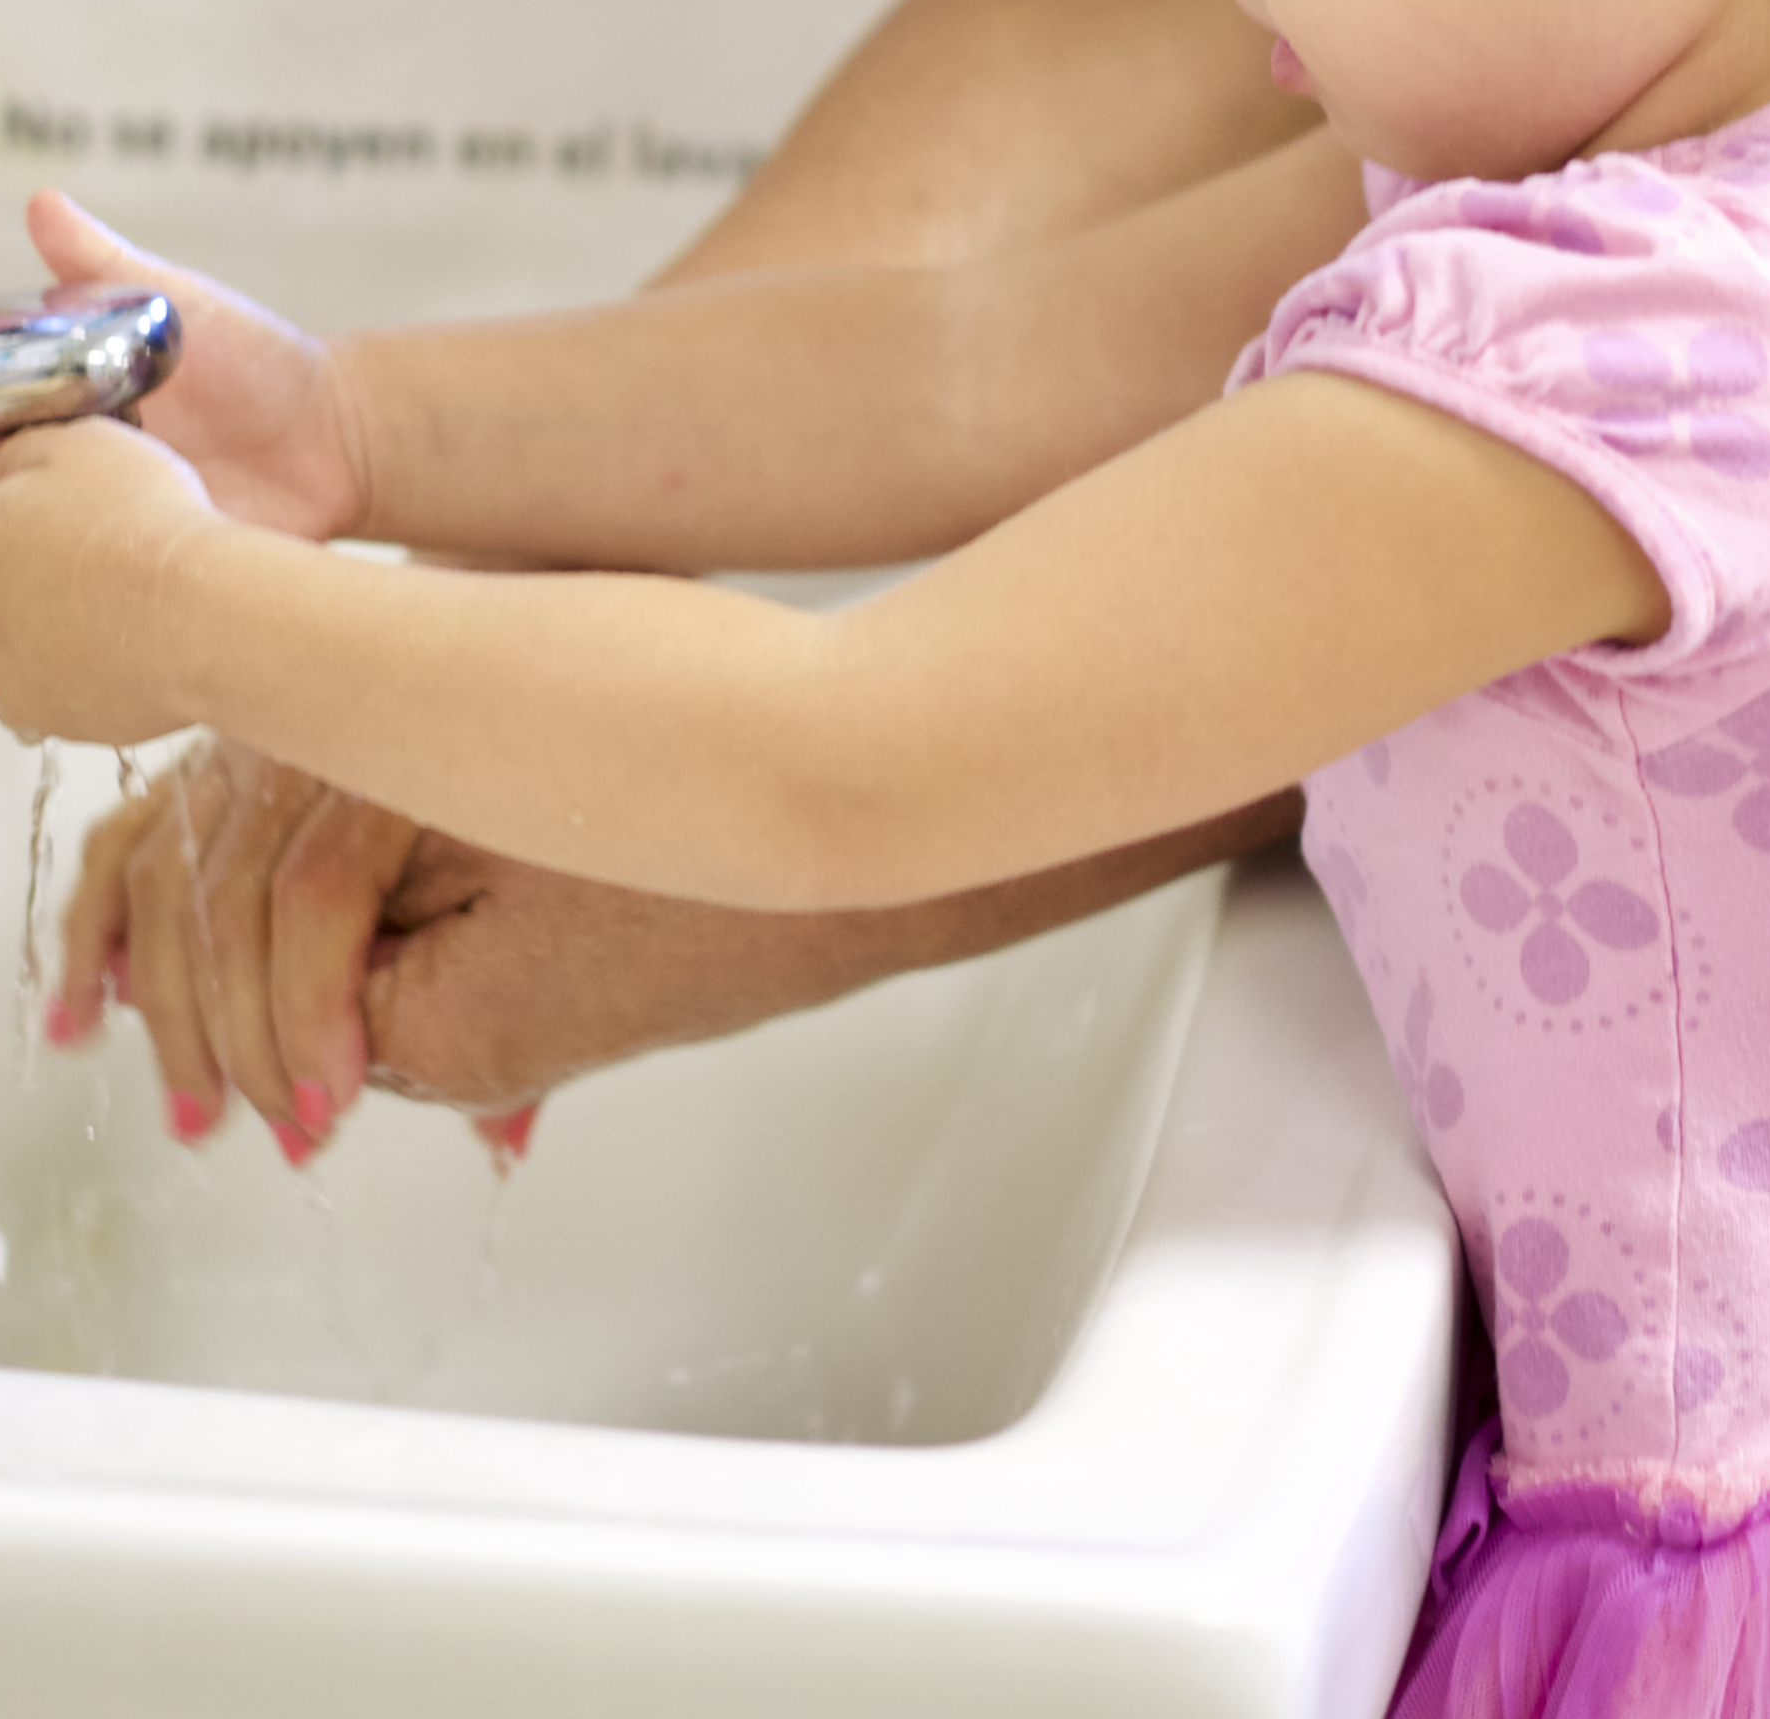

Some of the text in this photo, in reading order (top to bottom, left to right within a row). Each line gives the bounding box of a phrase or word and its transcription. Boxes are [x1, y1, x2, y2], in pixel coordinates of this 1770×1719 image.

[0, 94, 89, 152] No
[112, 106, 173, 158] se
[202, 112, 437, 180] apoyen
[457, 124, 535, 177] en
[552, 116, 615, 180] el
